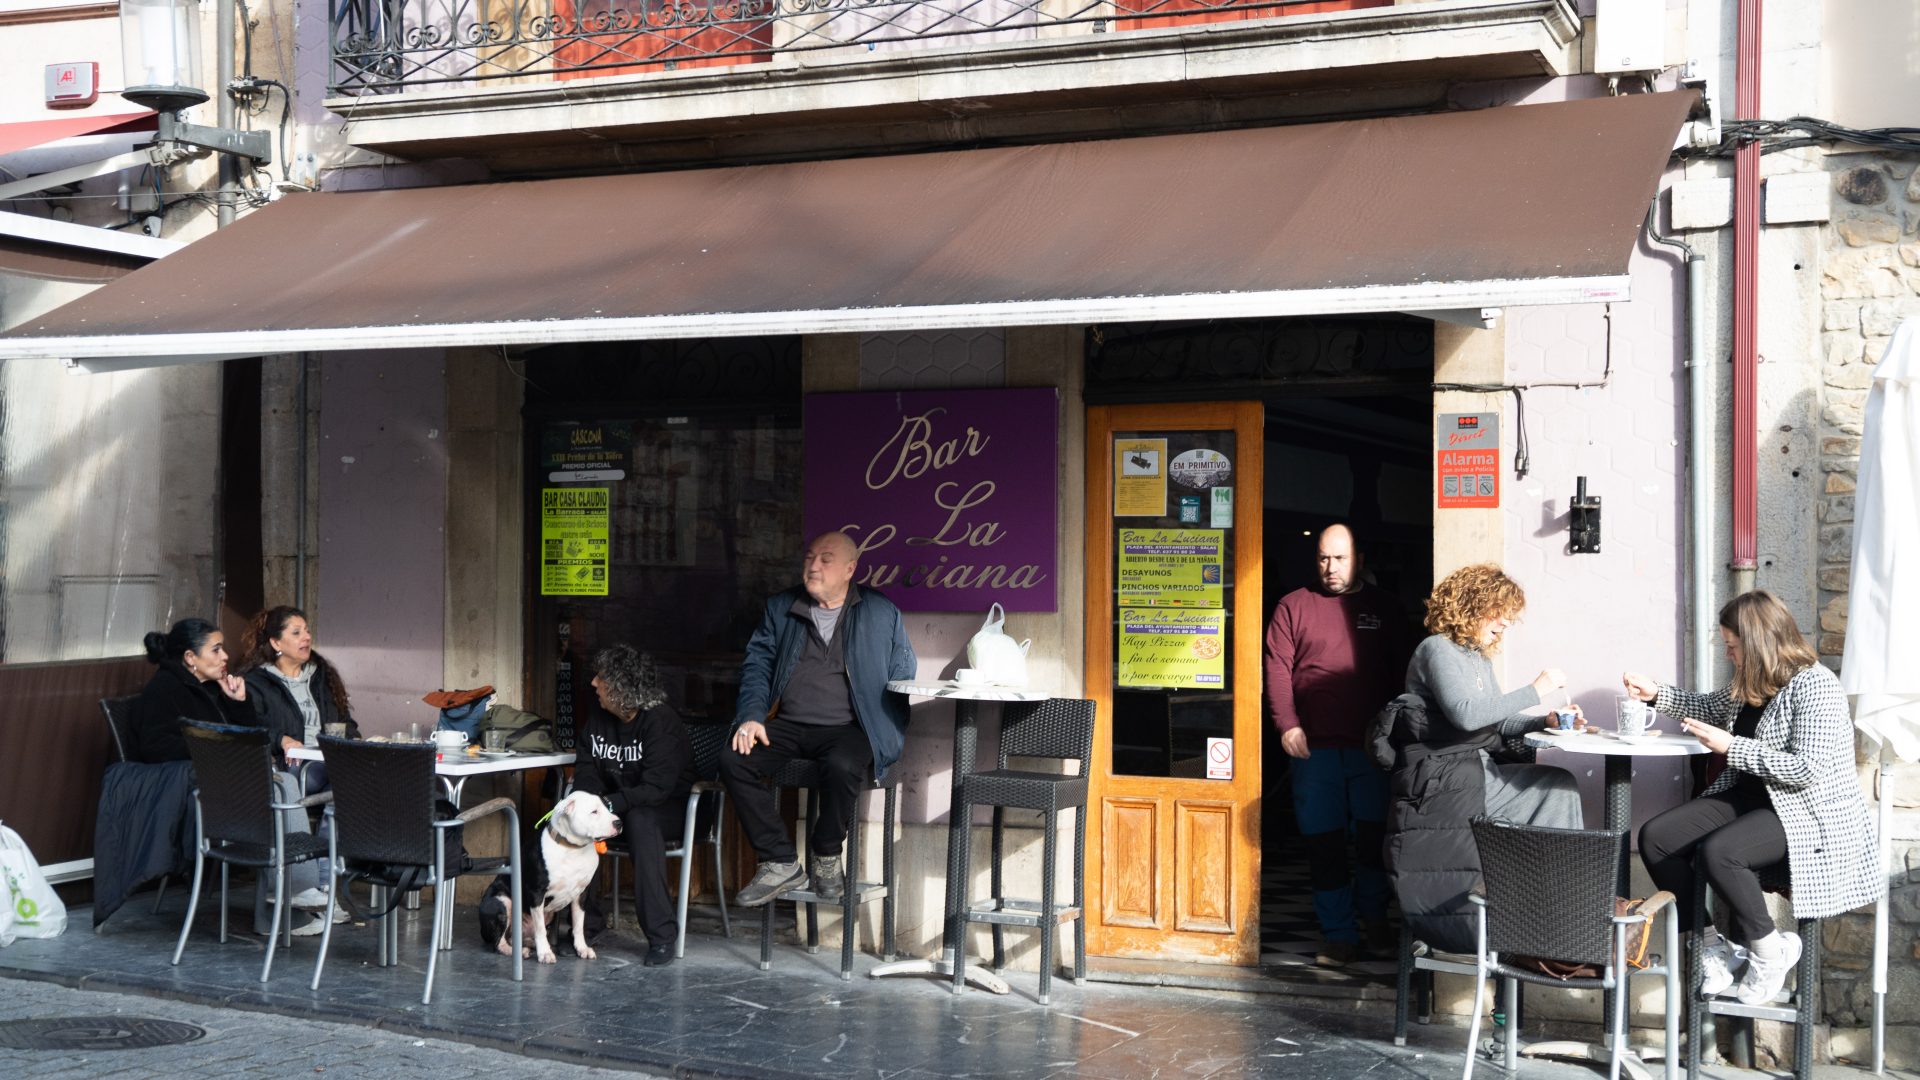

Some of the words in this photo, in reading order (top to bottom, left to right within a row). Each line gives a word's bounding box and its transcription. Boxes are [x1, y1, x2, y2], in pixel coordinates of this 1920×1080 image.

[1449, 428, 1488, 446] Direct
[865, 407, 991, 490] Bar
[1173, 462, 1185, 470] EM
[1188, 461, 1227, 469] PRIMITIVO
[1443, 453, 1494, 465] Alarma
[544, 492, 558, 507] BAR
[559, 492, 577, 507] CASA
[578, 491, 607, 507] CLAUDIO
[905, 480, 1007, 547] La
[1123, 531, 1146, 543] Bar
[1149, 531, 1168, 543] La
[1172, 531, 1221, 543] Luciana
[838, 523, 1047, 589] Luciana
[1123, 610, 1146, 622] Bar
[1150, 610, 1168, 622] La
[1173, 611, 1221, 623] Luciana
[1122, 636, 1147, 649] Hay
[1150, 636, 1186, 647] Pizzas
[1124, 653, 1142, 664] fin
[1146, 653, 1158, 664] de
[1129, 671, 1149, 683] por
[1151, 674, 1192, 683] encargo
